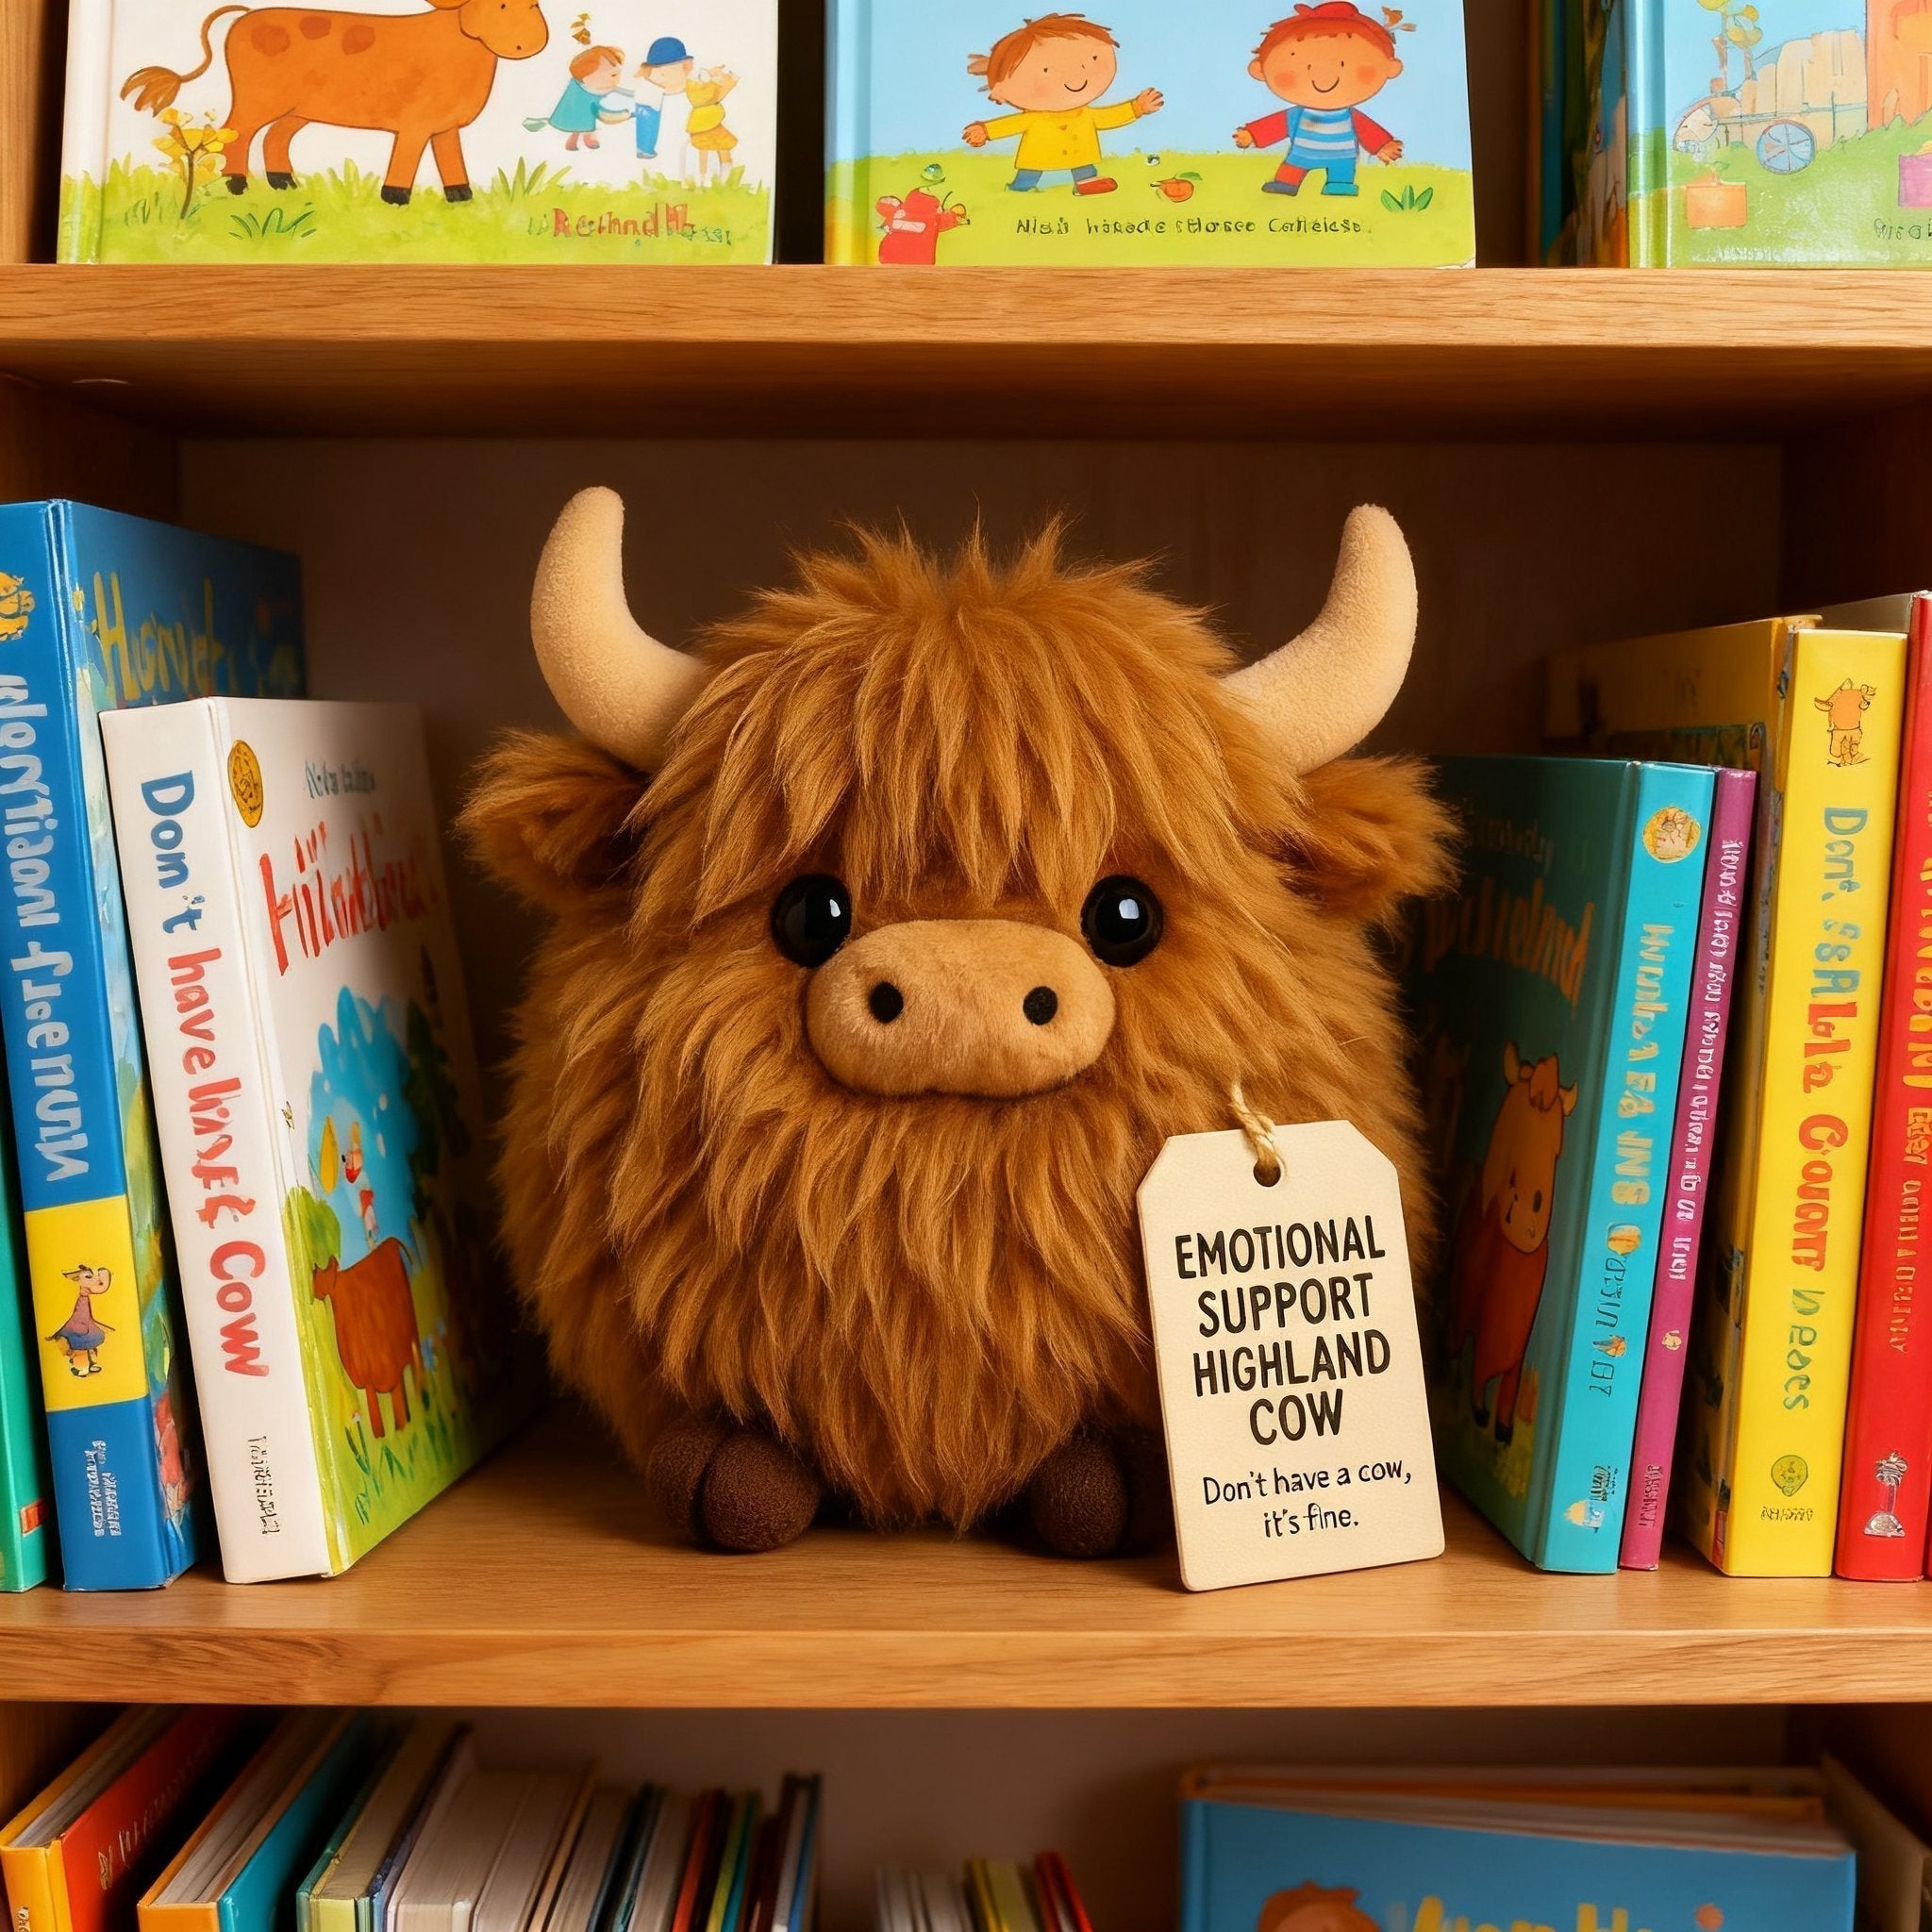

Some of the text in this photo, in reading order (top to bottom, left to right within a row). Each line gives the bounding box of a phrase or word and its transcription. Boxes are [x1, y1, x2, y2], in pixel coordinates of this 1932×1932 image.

[141, 770, 205, 934] Don't
[168, 947, 227, 1075] have
[1174, 1215, 1386, 1279] EMOTIONAL
[209, 1240, 270, 1378] Cow
[1198, 1272, 1374, 1338] SUPPORT
[1192, 1328, 1391, 1397] HIGHLAND
[1249, 1388, 1343, 1445] COW
[1203, 1460, 1411, 1505] Don't have a cow,
[1263, 1502, 1359, 1538] it's fine.
